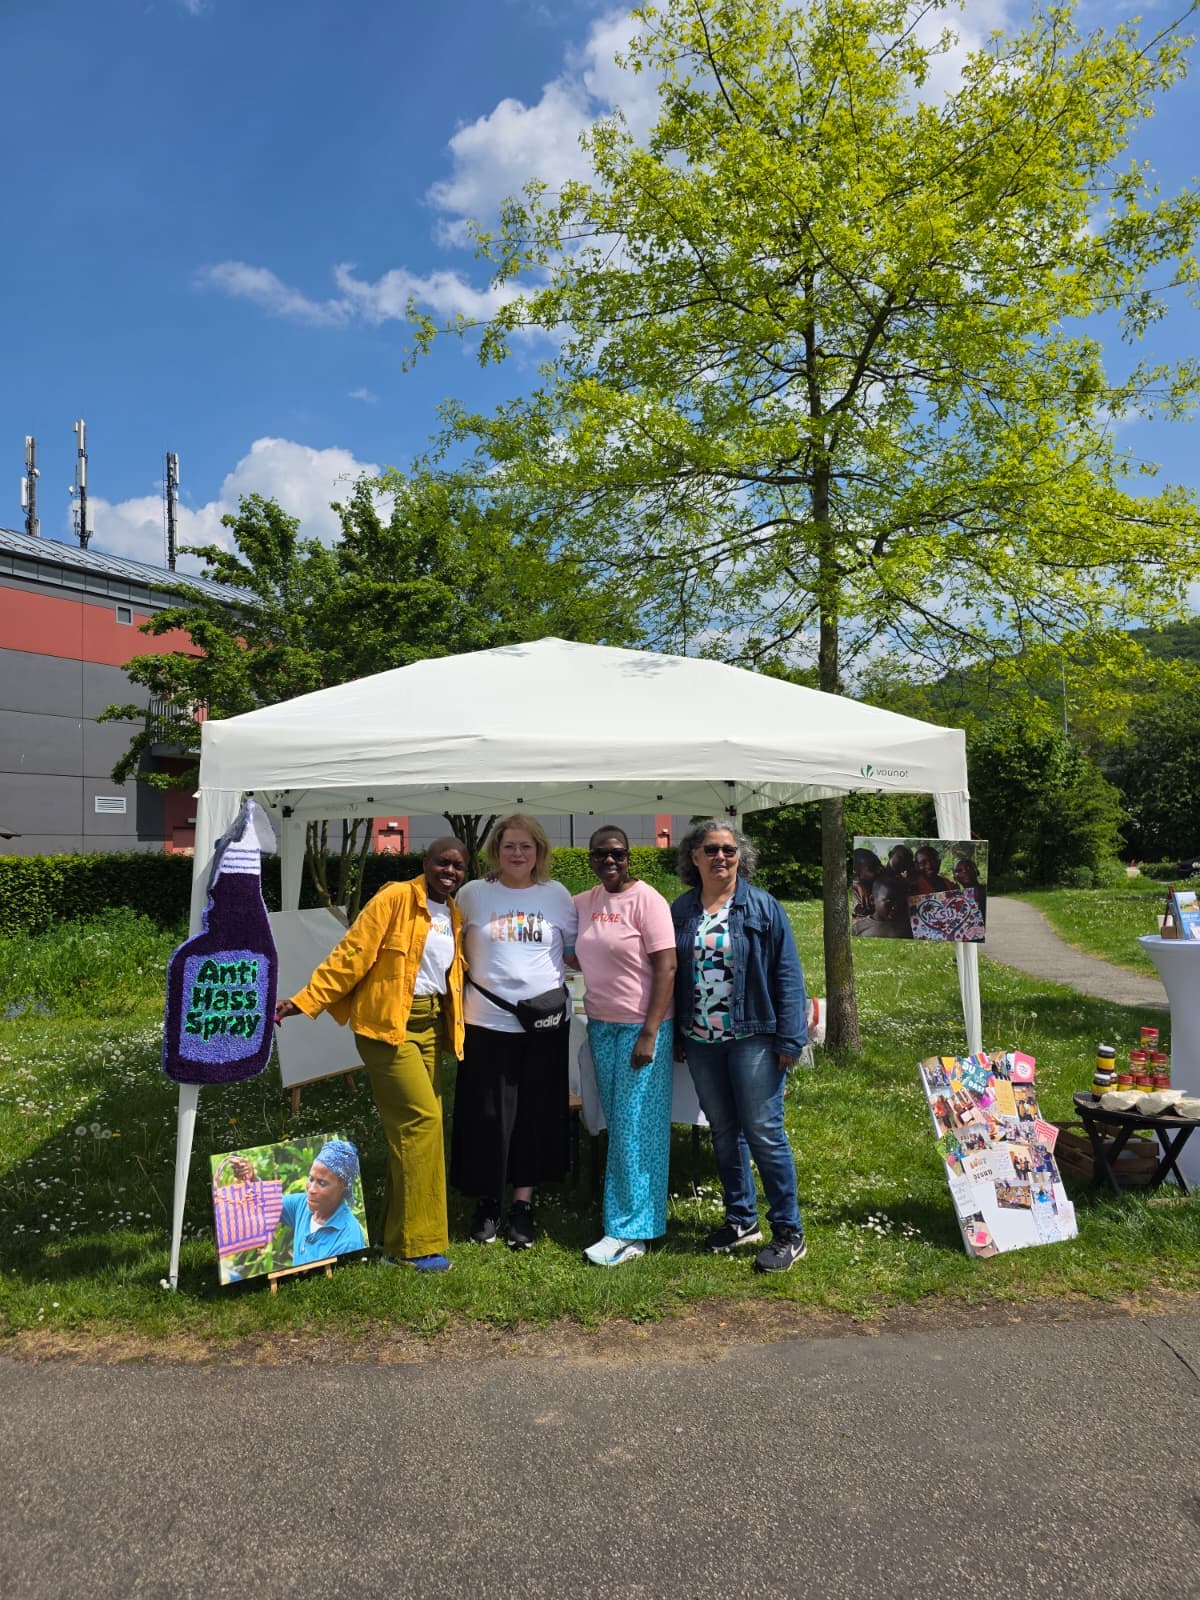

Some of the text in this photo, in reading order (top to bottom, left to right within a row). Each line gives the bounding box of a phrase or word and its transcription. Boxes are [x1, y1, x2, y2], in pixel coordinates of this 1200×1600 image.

[197, 959, 258, 985] Anti
[192, 986, 258, 1011] Hass
[185, 1011, 261, 1042] Spray
